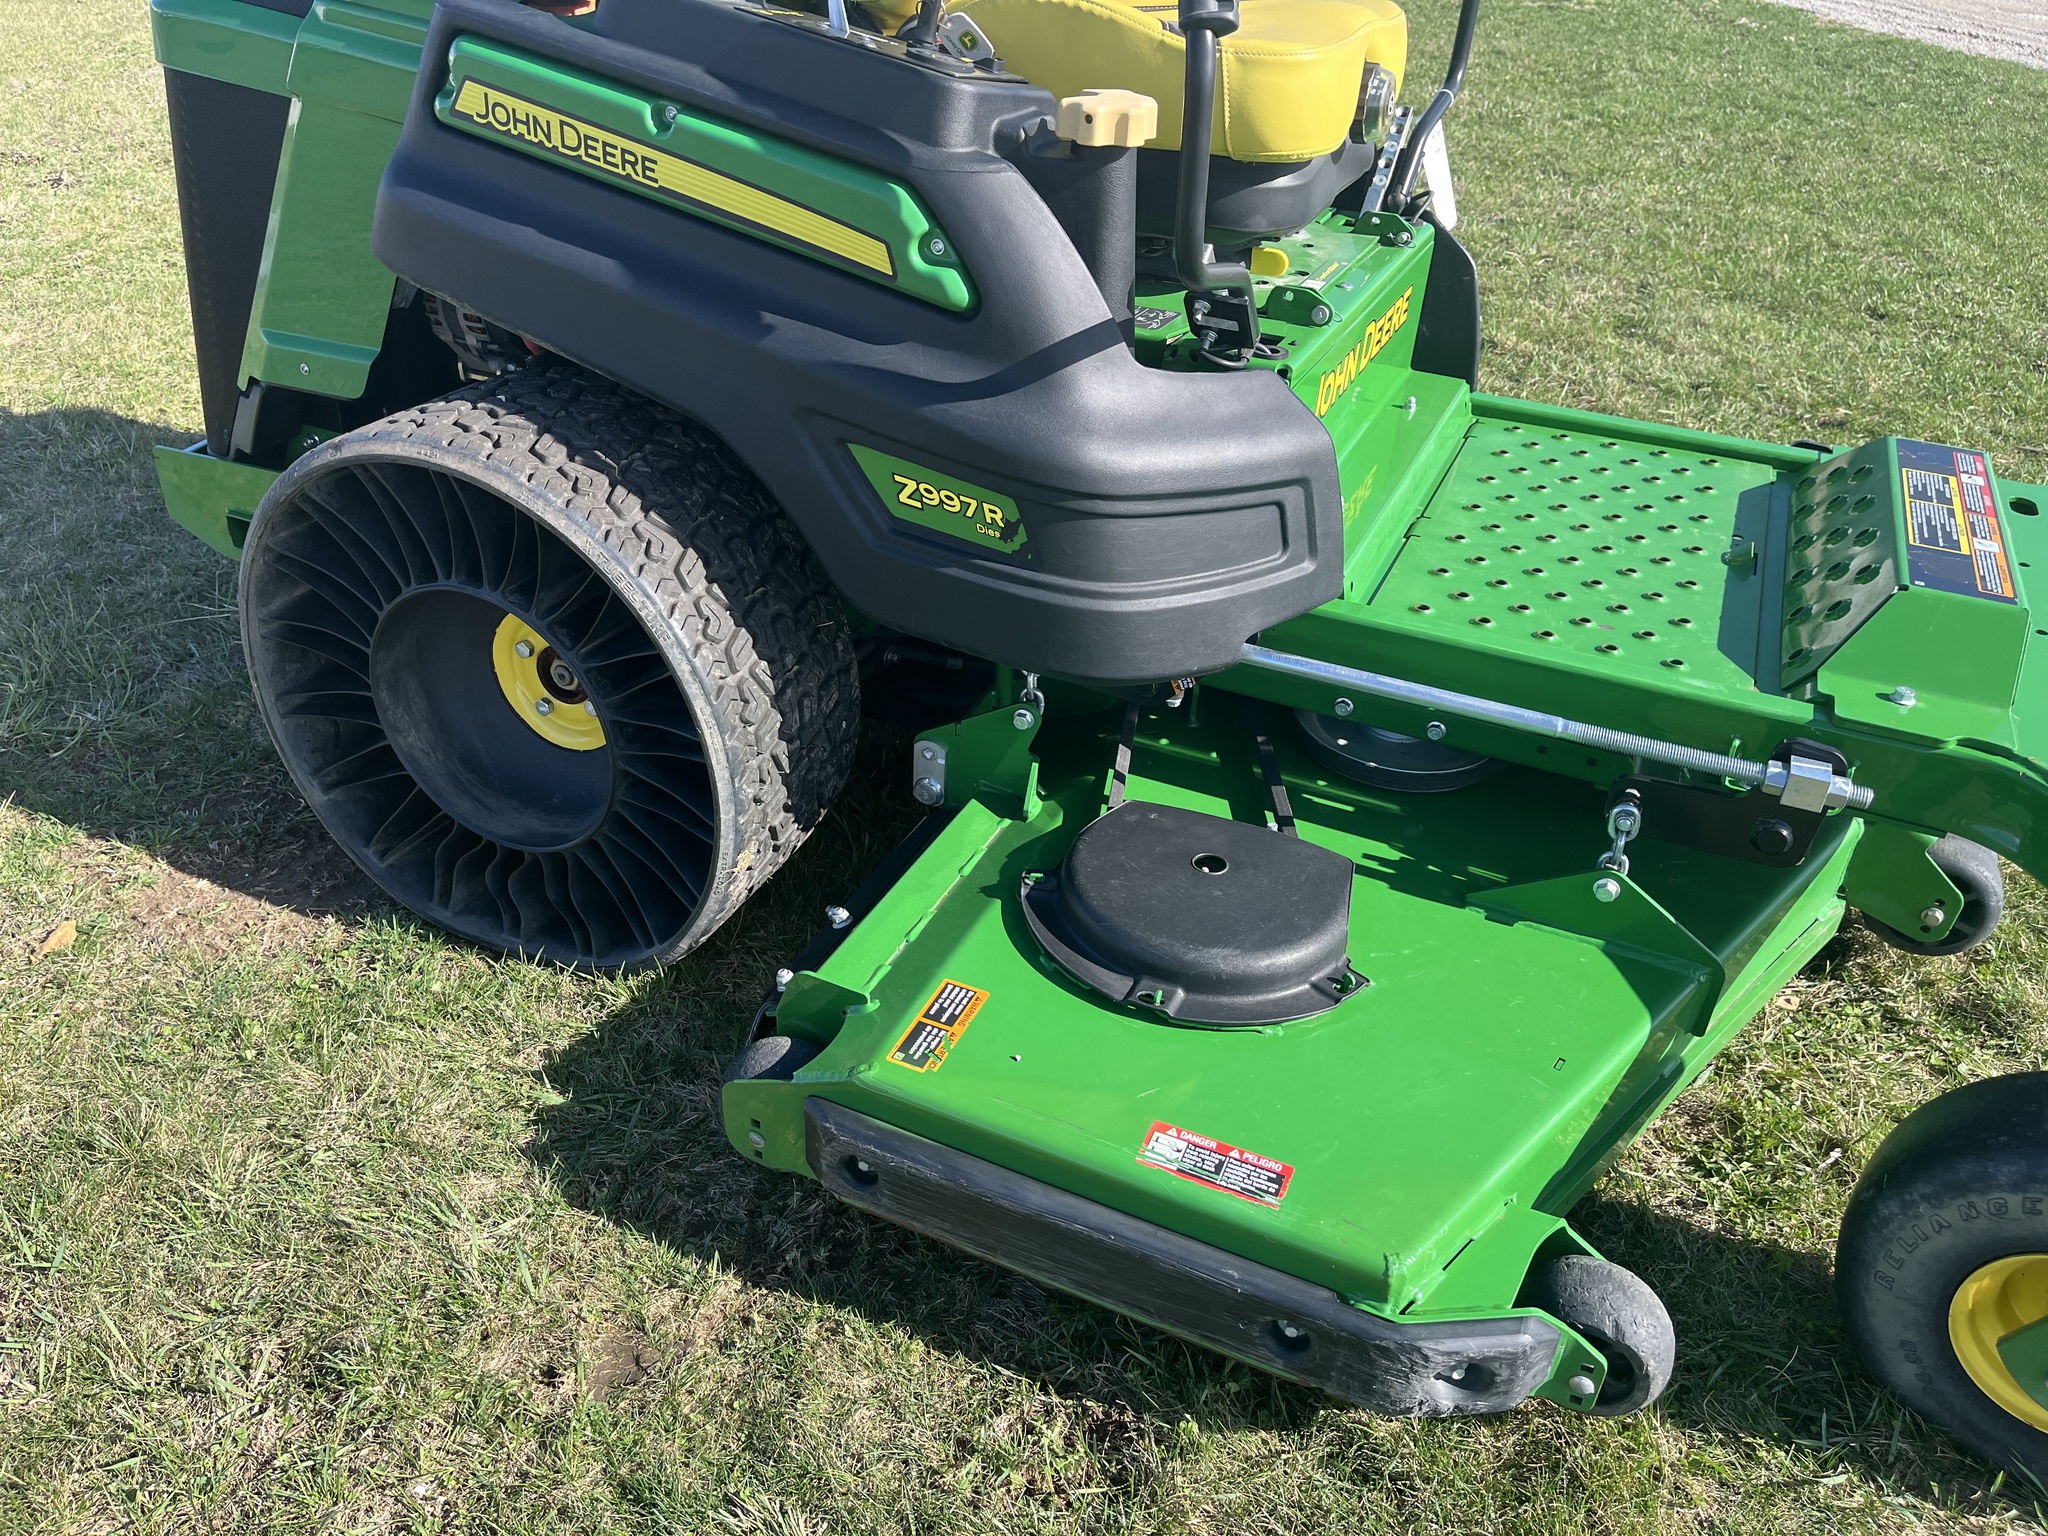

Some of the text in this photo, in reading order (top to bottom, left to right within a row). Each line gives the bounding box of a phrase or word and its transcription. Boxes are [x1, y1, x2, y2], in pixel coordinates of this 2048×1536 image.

[475, 92, 659, 185] JOHN DEERE
[1315, 339, 1361, 418] JOHN
[1358, 284, 1414, 374] DEERE
[976, 523, 1001, 539] Dies
[958, 1000, 978, 1027] WARNING
[1180, 1130, 1217, 1150] DANGER
[1242, 1151, 1283, 1172] PELIGRO
[1873, 1195, 2044, 1291] RELIANCE
